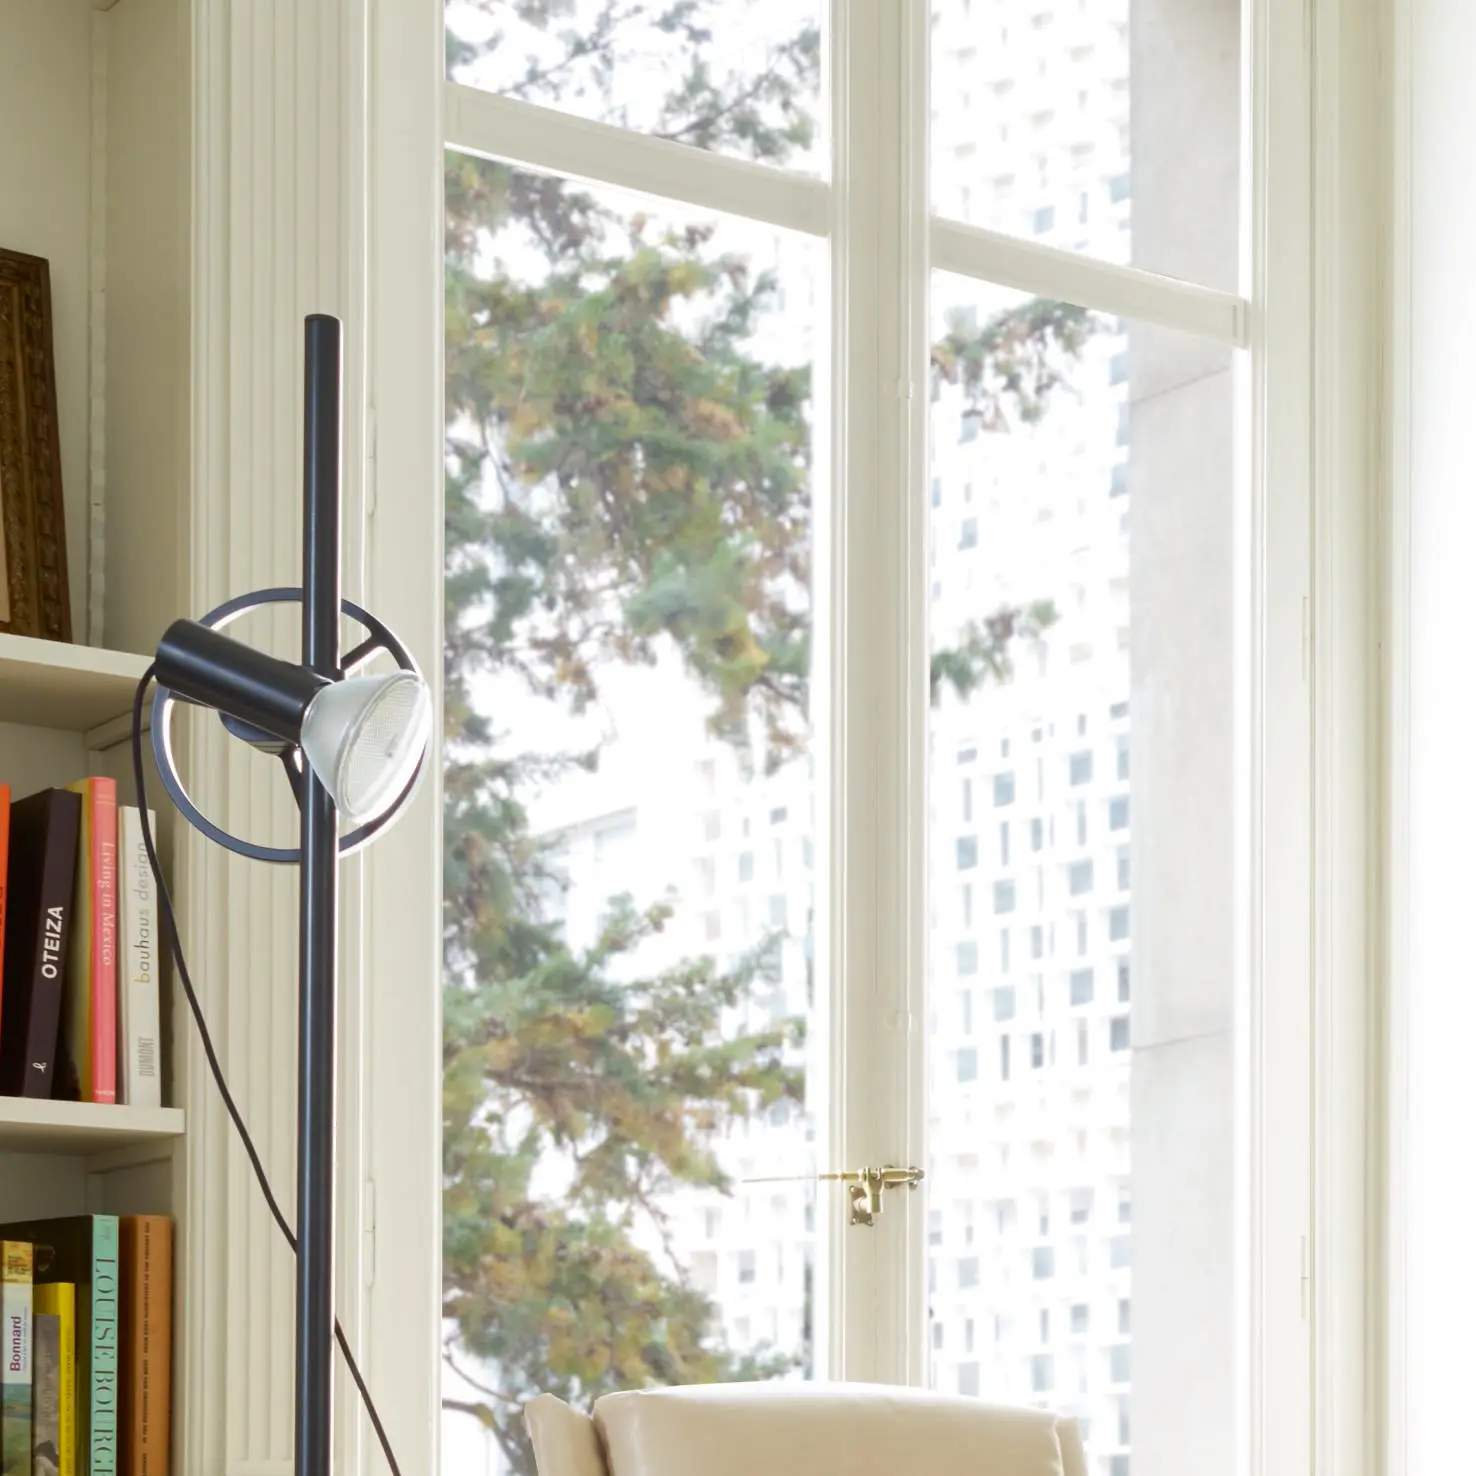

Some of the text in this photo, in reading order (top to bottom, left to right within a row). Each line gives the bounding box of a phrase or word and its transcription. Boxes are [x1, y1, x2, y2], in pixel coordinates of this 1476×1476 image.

[97, 842, 116, 966] Living in Mexico
[41, 906, 64, 979] OTEIZA
[134, 909, 151, 984] bauhaus
[9, 1316, 22, 1372] Bonnard
[95, 1258, 116, 1360] LOUISE
